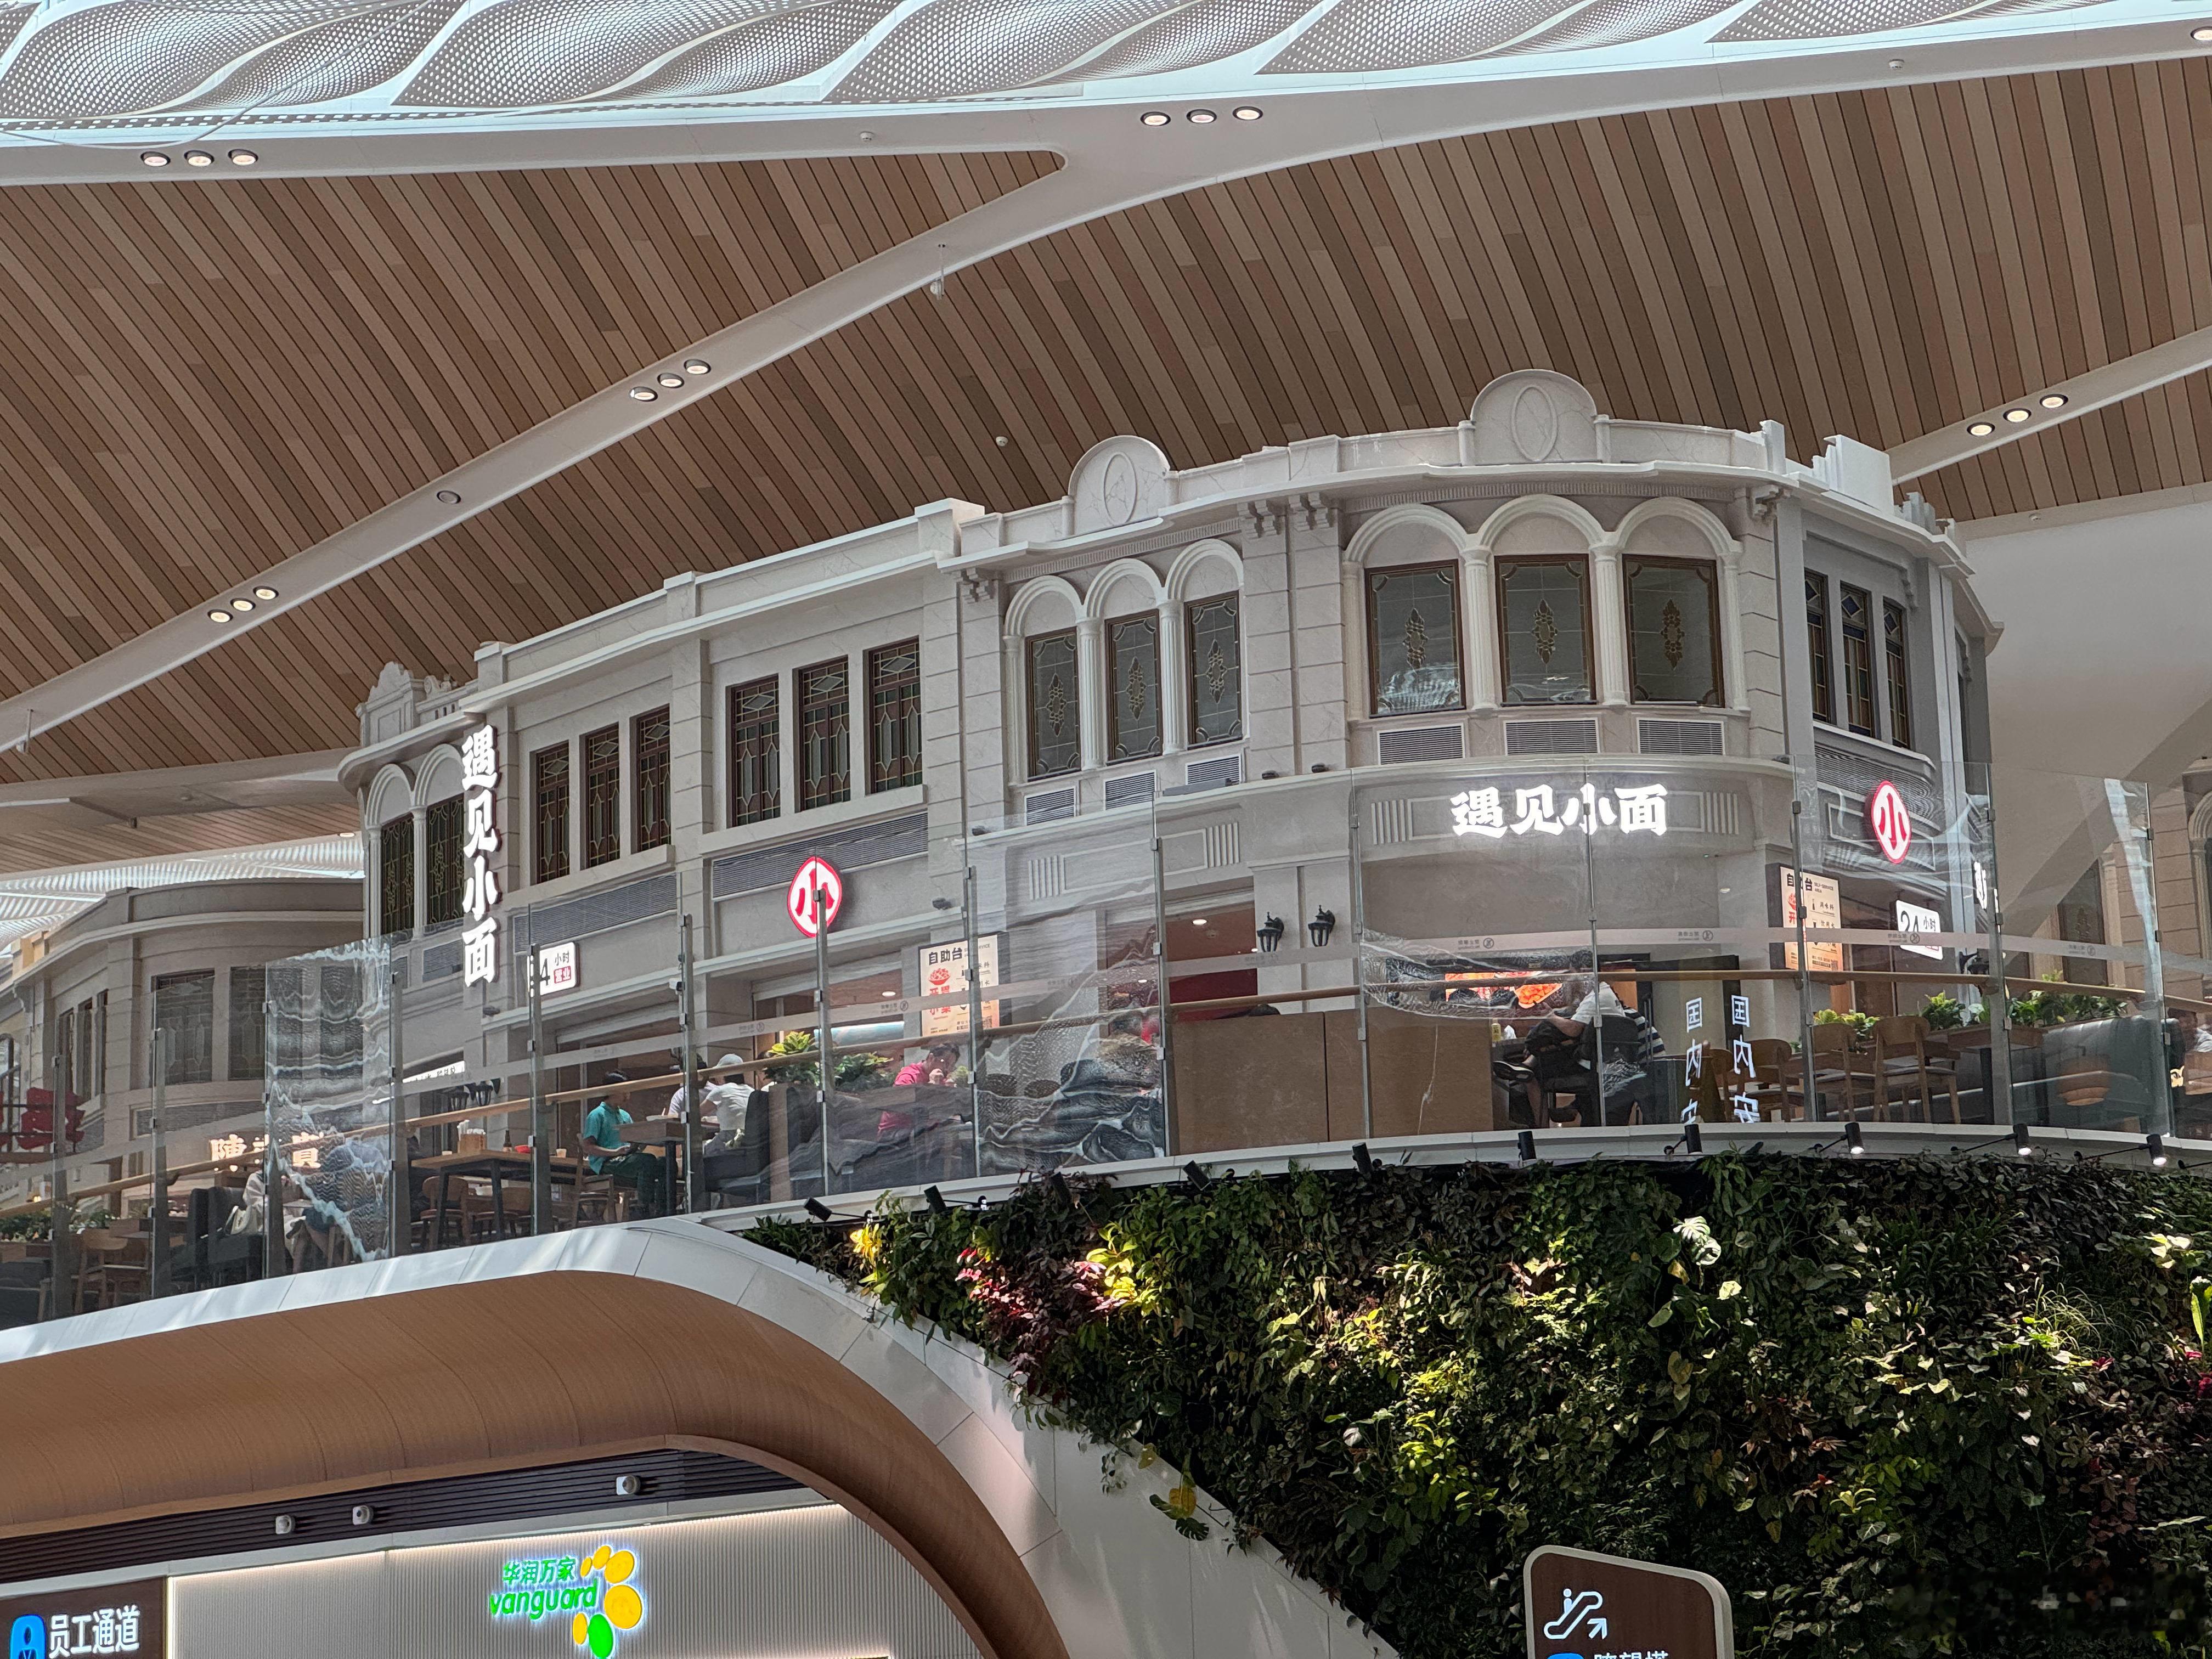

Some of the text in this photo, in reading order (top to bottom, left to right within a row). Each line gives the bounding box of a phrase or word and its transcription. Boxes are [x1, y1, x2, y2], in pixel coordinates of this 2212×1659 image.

[1450, 783, 1668, 839] 遇见小面
[1878, 792, 1907, 850] 小
[461, 724, 498, 987] 遇见小面
[795, 868, 834, 924] 小
[1787, 873, 1813, 891] 自台
[555, 950, 569, 966] 小时
[929, 947, 963, 966] 自助台
[503, 1556, 576, 1584] 华润万家
[490, 1578, 599, 1620] vanguard
[49, 1605, 140, 1658] 员工通道
